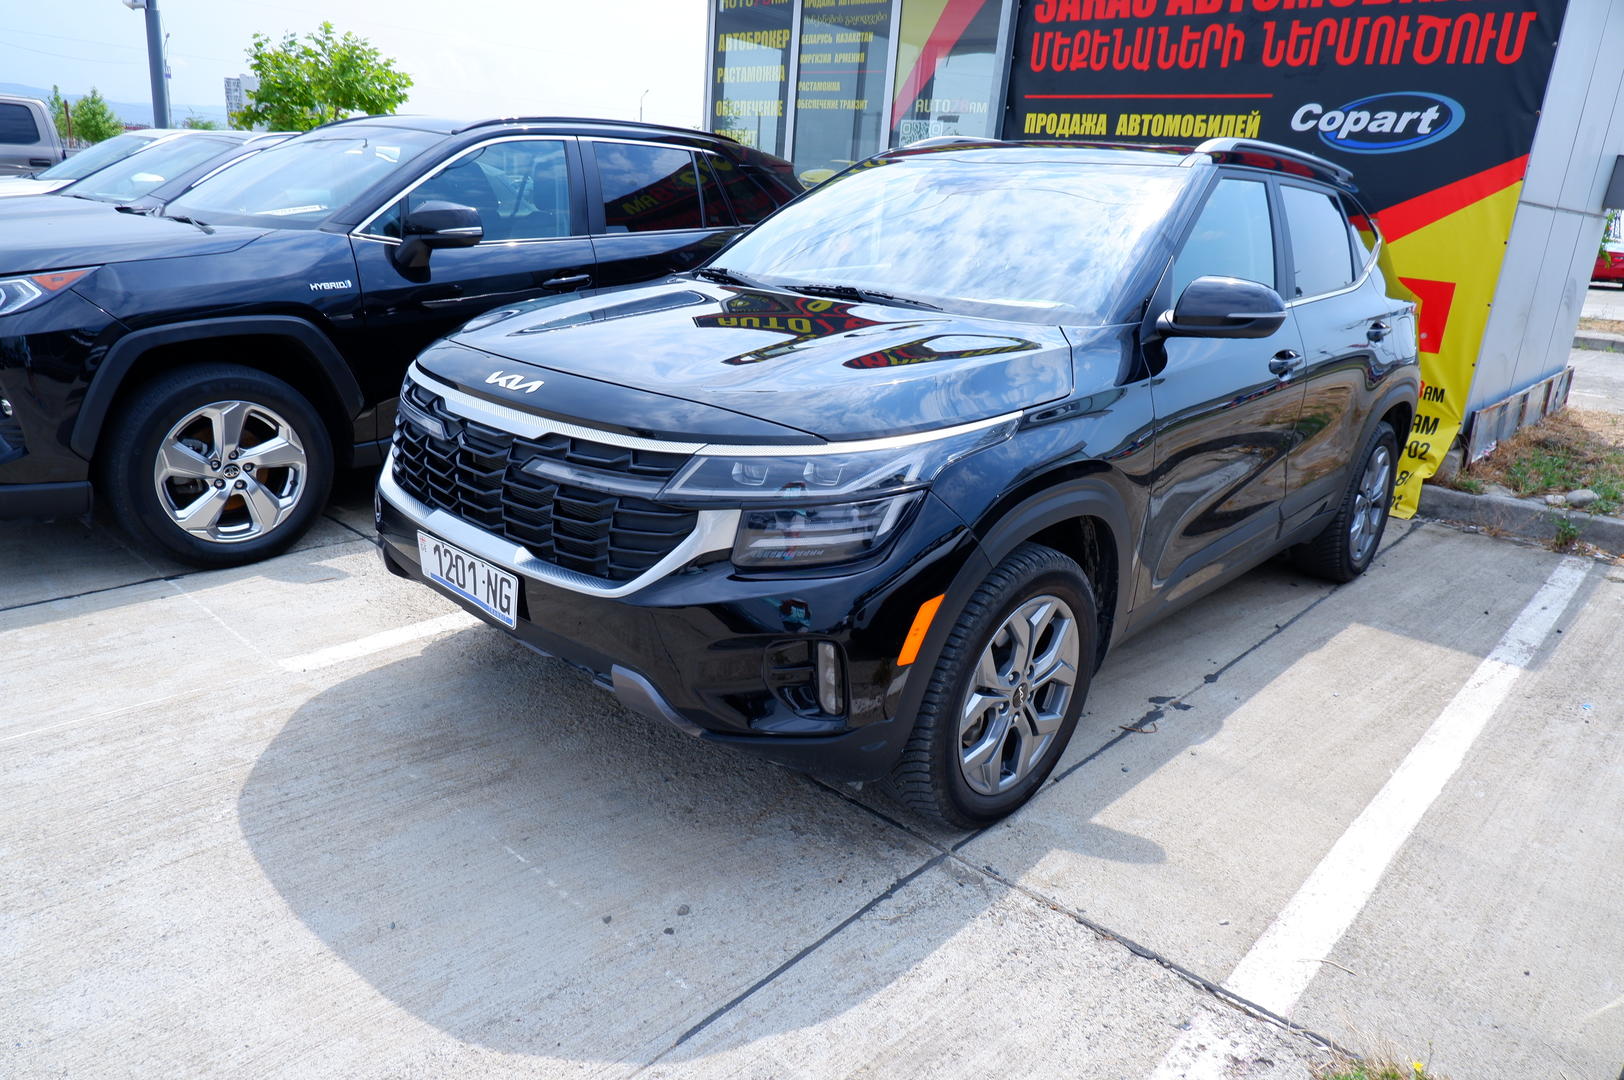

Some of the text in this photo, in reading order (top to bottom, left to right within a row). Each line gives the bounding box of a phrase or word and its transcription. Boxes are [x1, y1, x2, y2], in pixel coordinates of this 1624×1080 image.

[718, 29, 790, 52] АВТОБРОКЕР
[801, 33, 832, 45] БЕЛАРУСЬ
[1030, 12, 1537, 73] ՄԵՔԵՆԱՆԵՐԻ ՆԵՐՄՈՒԾՈՒՄ
[717, 65, 785, 84] РАСТАМОЖКА
[798, 81, 841, 92] РАСТАМОЖКА
[715, 100, 784, 117] ОБЕСПЕЧЕНИЕ
[797, 98, 869, 110] ОБЕСПЕЧЕНИЕ ТРАНЗИТ
[1024, 110, 1261, 138] ПРОДАЖА АВТОМОБИЛЕЙ
[1290, 103, 1440, 139] Copart
[310, 281, 348, 291] HYBRID
